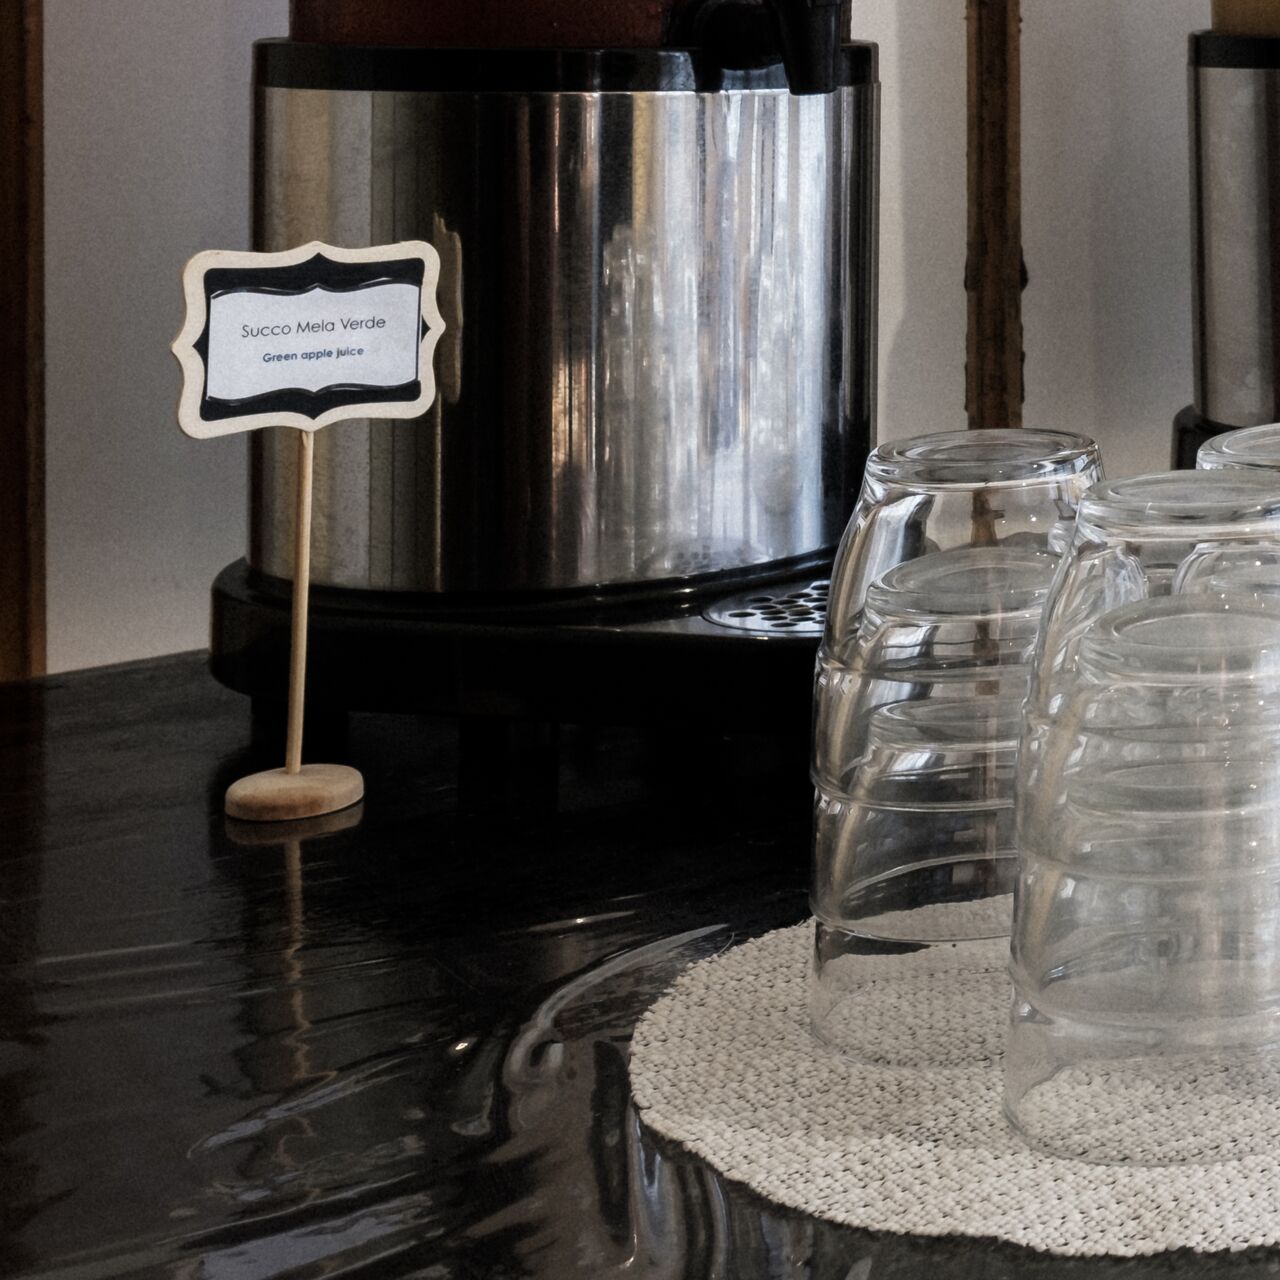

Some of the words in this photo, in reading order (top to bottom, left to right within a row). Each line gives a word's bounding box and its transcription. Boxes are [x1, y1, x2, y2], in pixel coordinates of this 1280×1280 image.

[241, 323, 292, 338] Succo
[296, 319, 335, 334] Mela
[340, 316, 386, 331] Verde
[262, 351, 298, 363] Green
[301, 348, 333, 361] apple
[336, 346, 364, 359] juice
